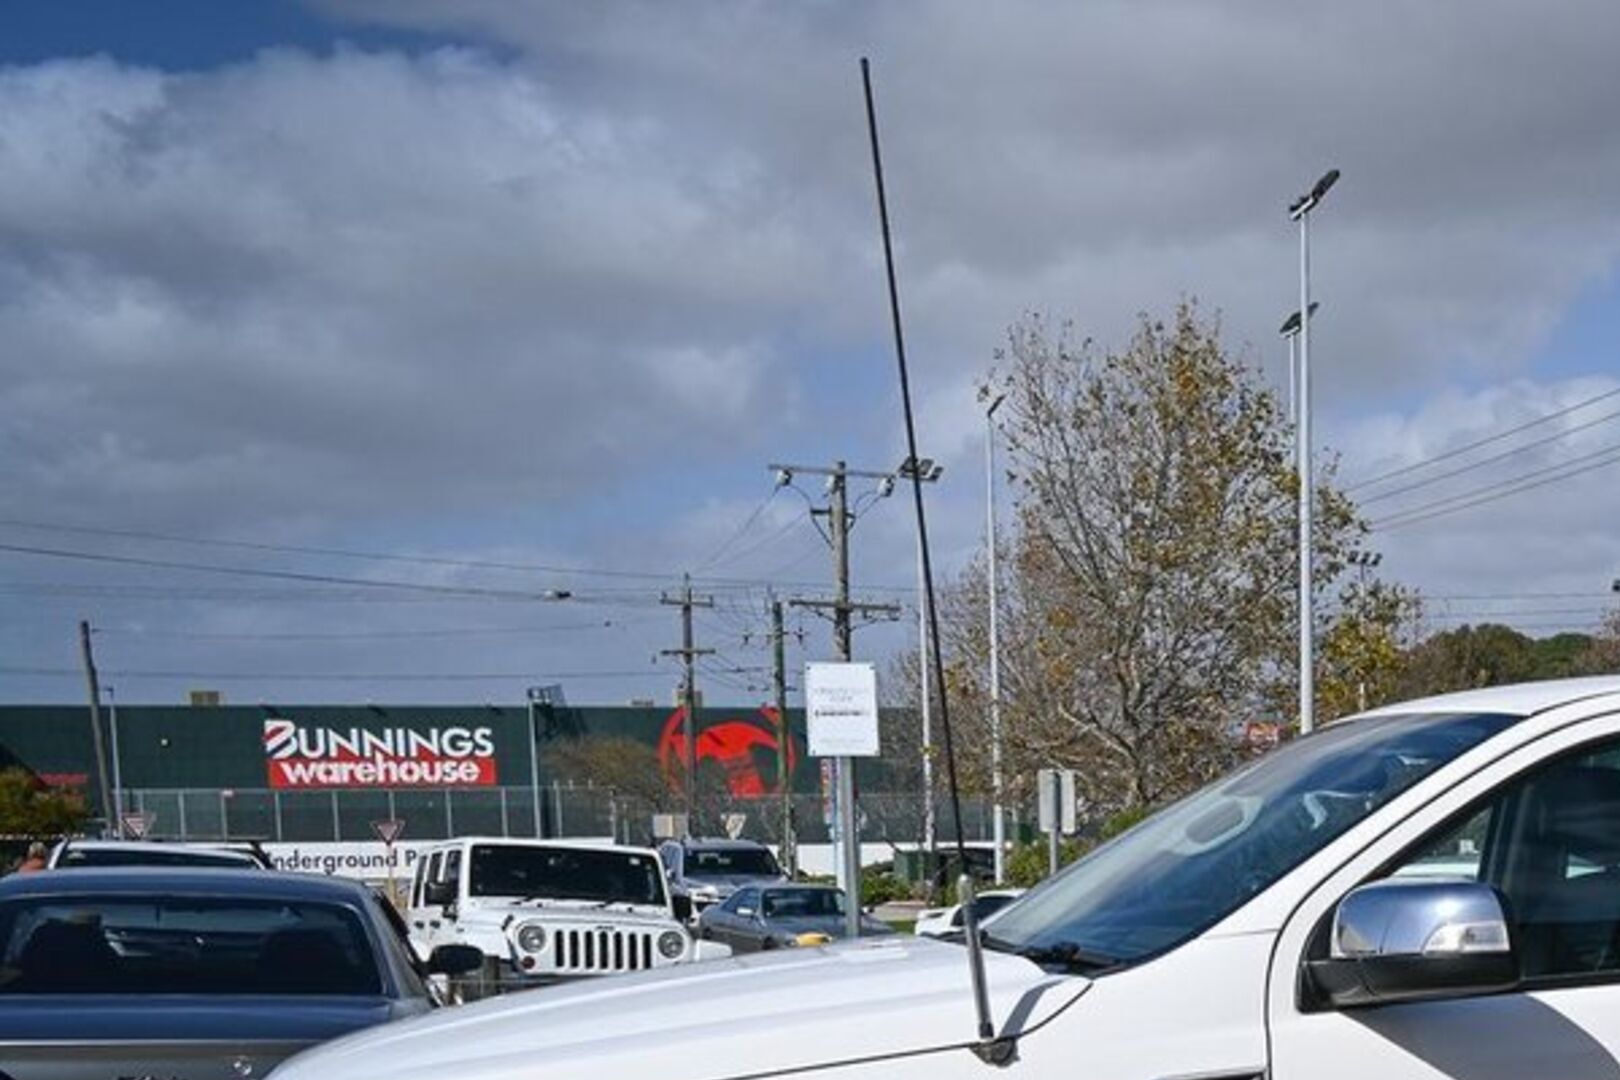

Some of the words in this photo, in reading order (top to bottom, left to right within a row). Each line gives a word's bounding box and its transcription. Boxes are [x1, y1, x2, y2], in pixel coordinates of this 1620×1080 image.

[263, 719, 495, 759] BUNNINGS
[280, 750, 481, 785] warehouse
[268, 849, 398, 876] nderground
